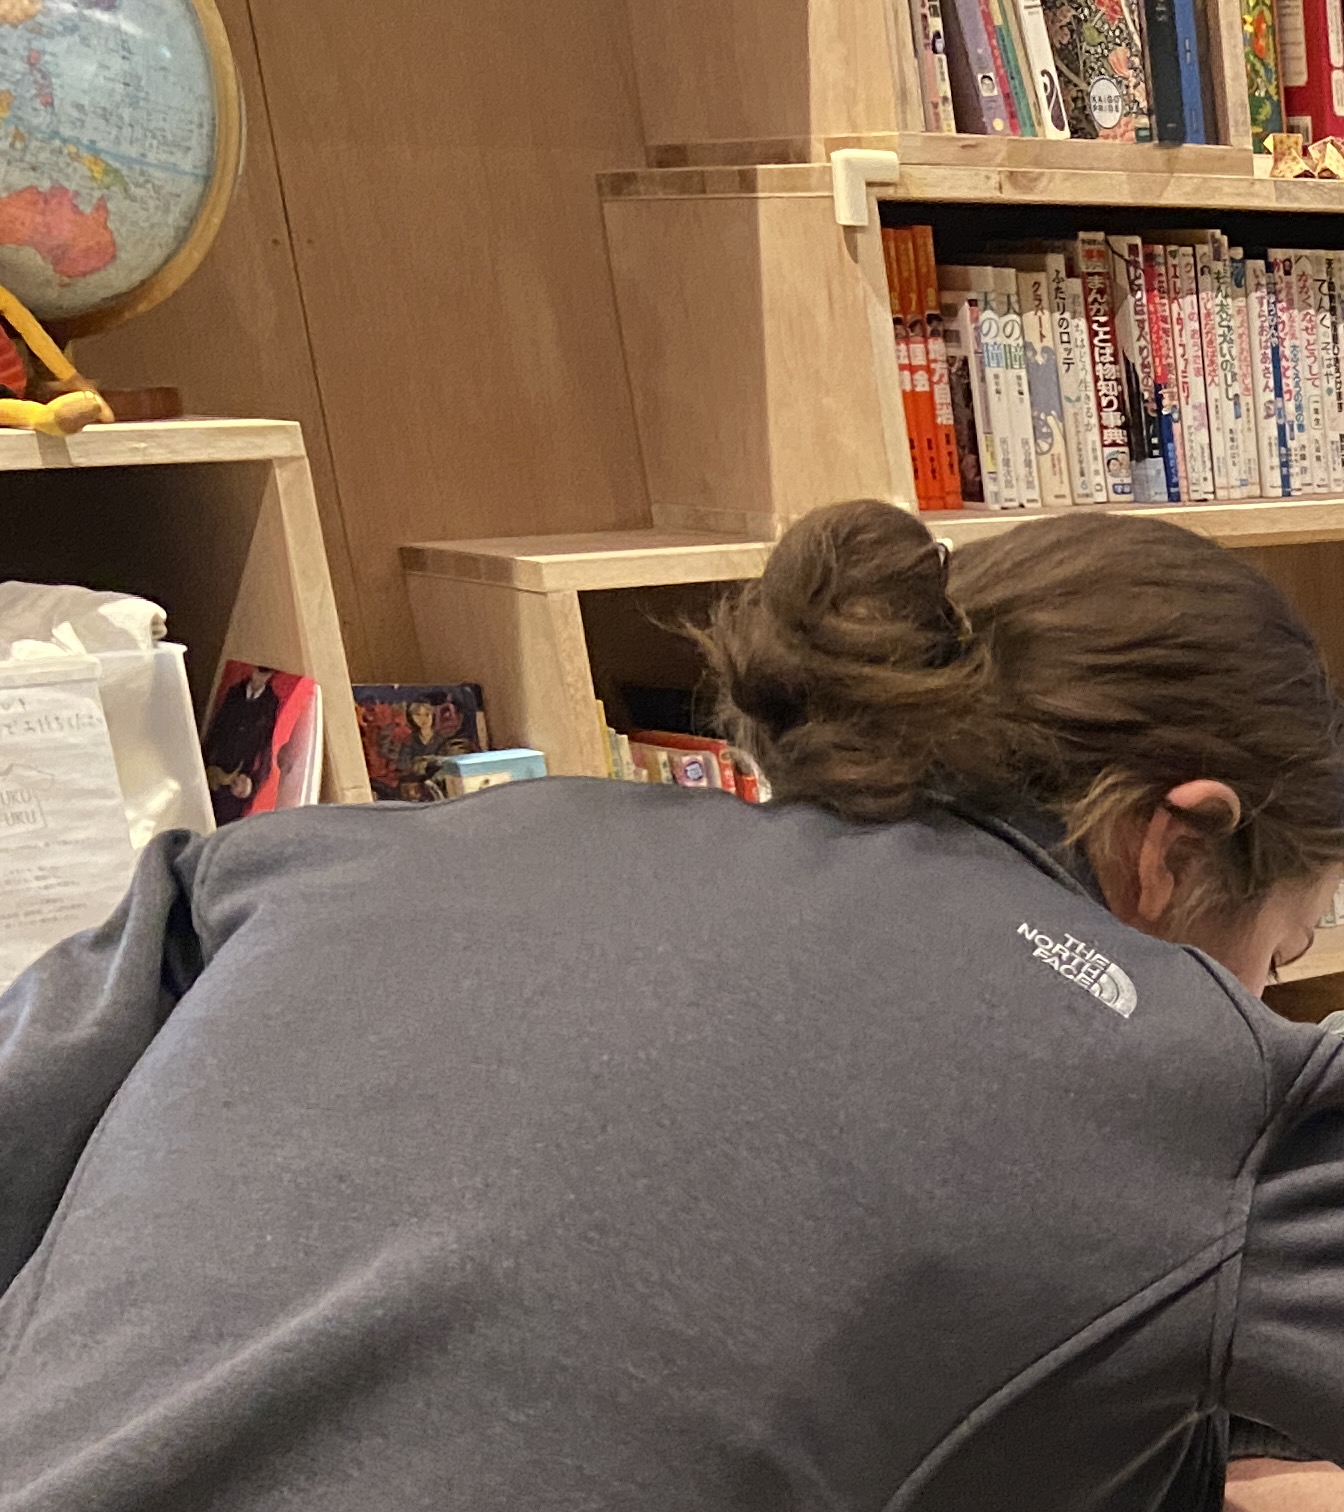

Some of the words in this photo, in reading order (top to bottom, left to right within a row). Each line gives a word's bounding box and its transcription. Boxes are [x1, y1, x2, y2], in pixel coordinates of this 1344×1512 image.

[1051, 269, 1076, 374] ふたりのロッテ
[1016, 922, 1103, 980] NORTH
[1032, 947, 1095, 989] FACE
[1063, 932, 1111, 968] THE
